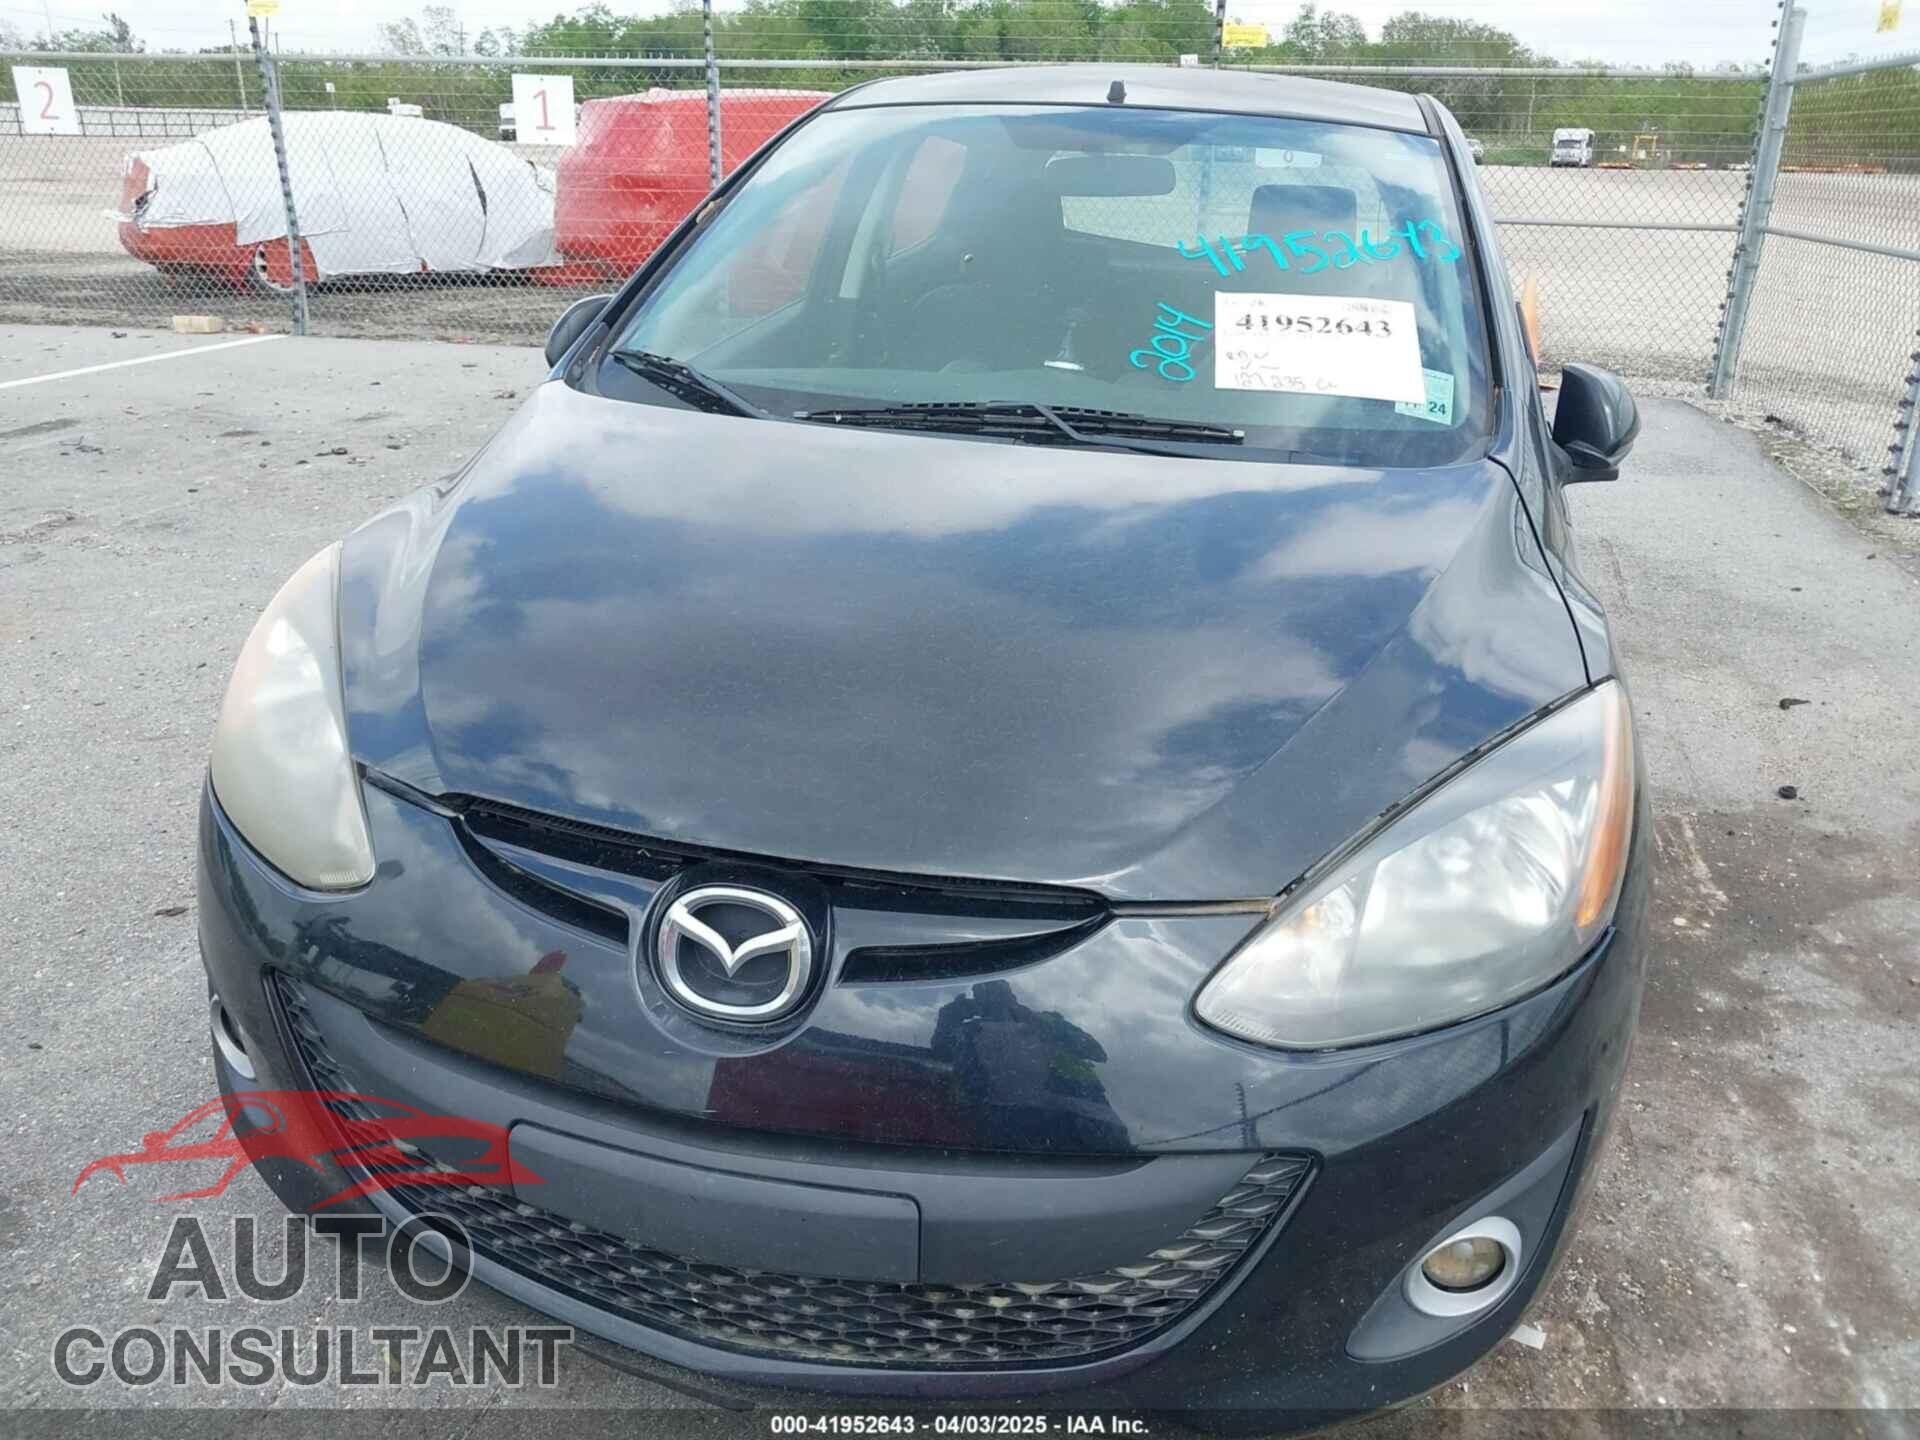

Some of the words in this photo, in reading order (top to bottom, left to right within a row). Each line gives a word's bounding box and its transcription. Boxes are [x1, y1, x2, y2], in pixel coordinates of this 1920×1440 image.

[33, 81, 60, 119] 2
[533, 88, 556, 131] 1
[1129, 302, 1214, 382] 2014
[1235, 313, 1393, 338] 41952643
[1428, 401, 1446, 415] 24
